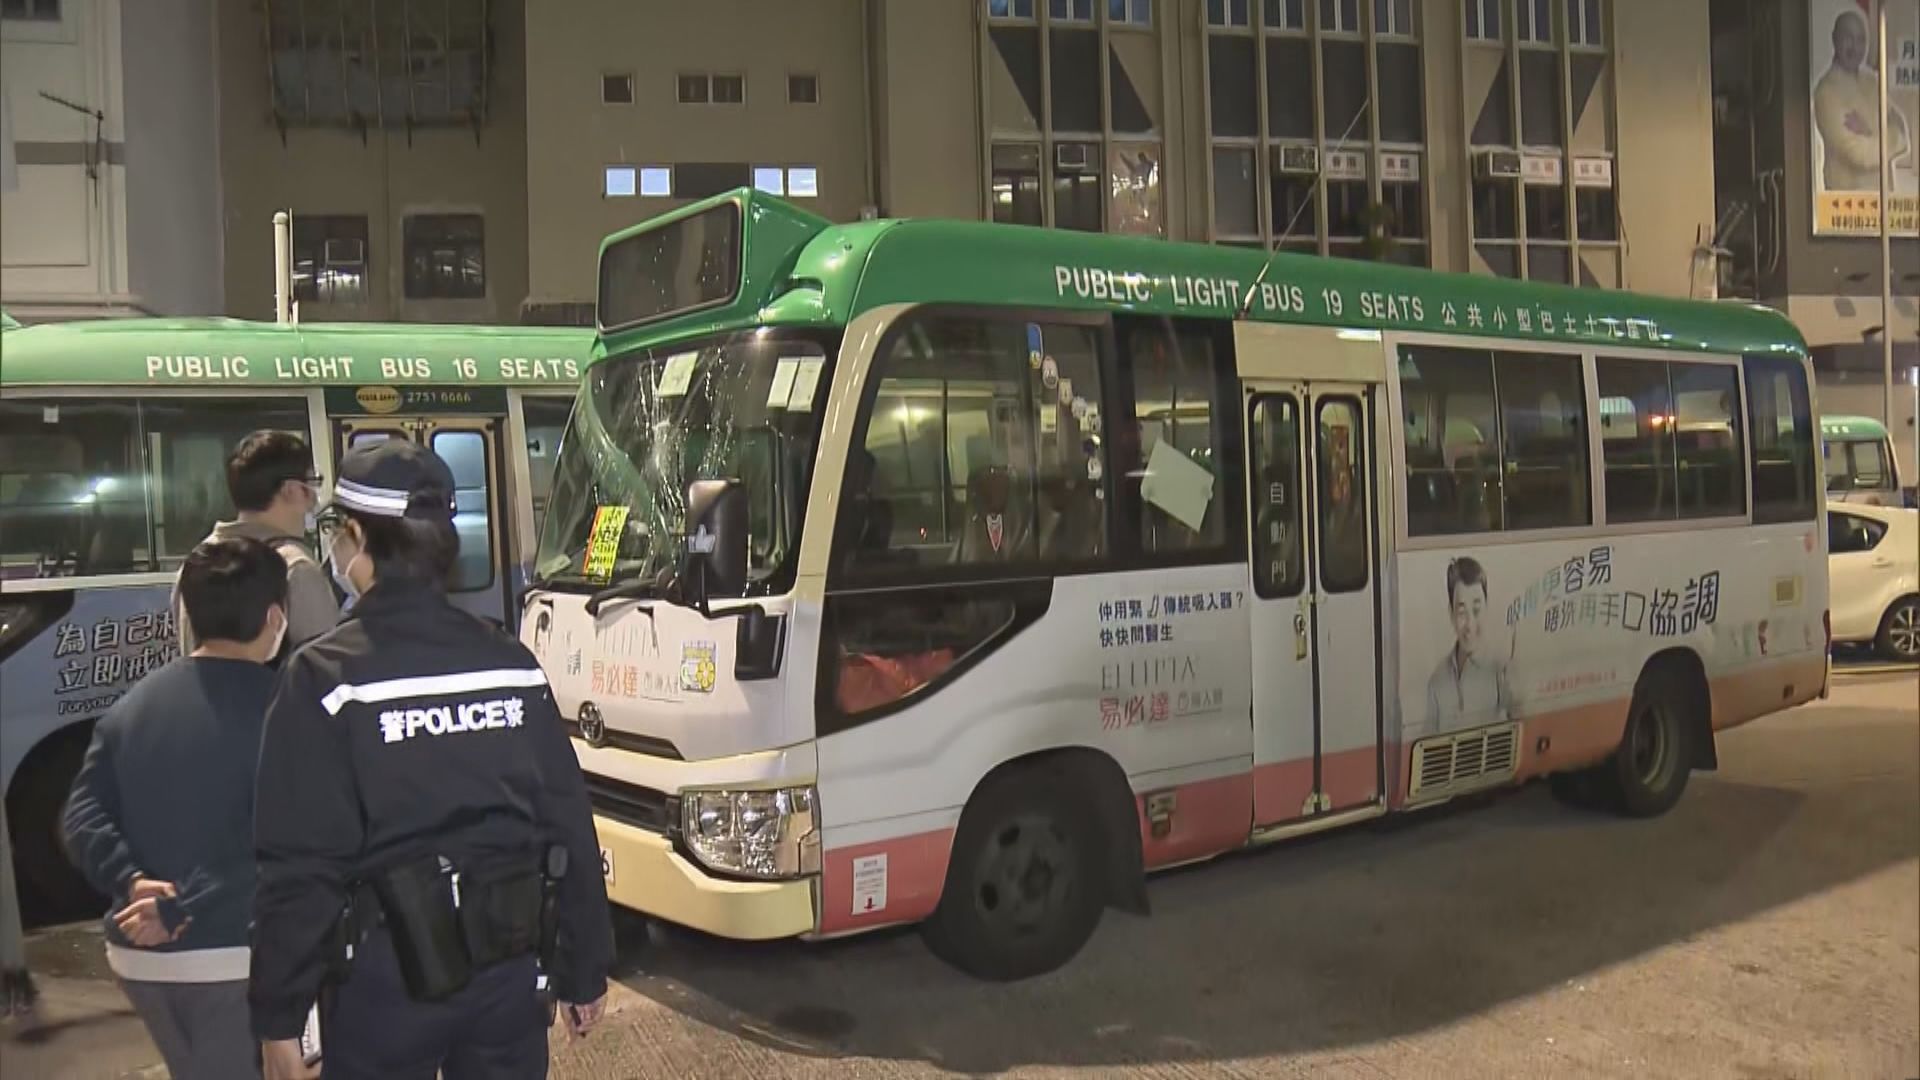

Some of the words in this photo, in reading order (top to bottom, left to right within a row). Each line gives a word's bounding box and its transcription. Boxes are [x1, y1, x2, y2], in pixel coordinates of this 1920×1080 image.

[1055, 265, 1150, 300] PUBLIC
[1172, 275, 1239, 307] LIGHT
[1261, 282, 1304, 312] BUS
[1321, 288, 1342, 316] 19
[1360, 291, 1424, 321] SEATS
[146, 356, 249, 379] PUBLIC
[275, 357, 353, 379] LIGHT
[380, 357, 430, 379] BUS
[452, 357, 477, 379] 16
[500, 357, 579, 380] SEATS
